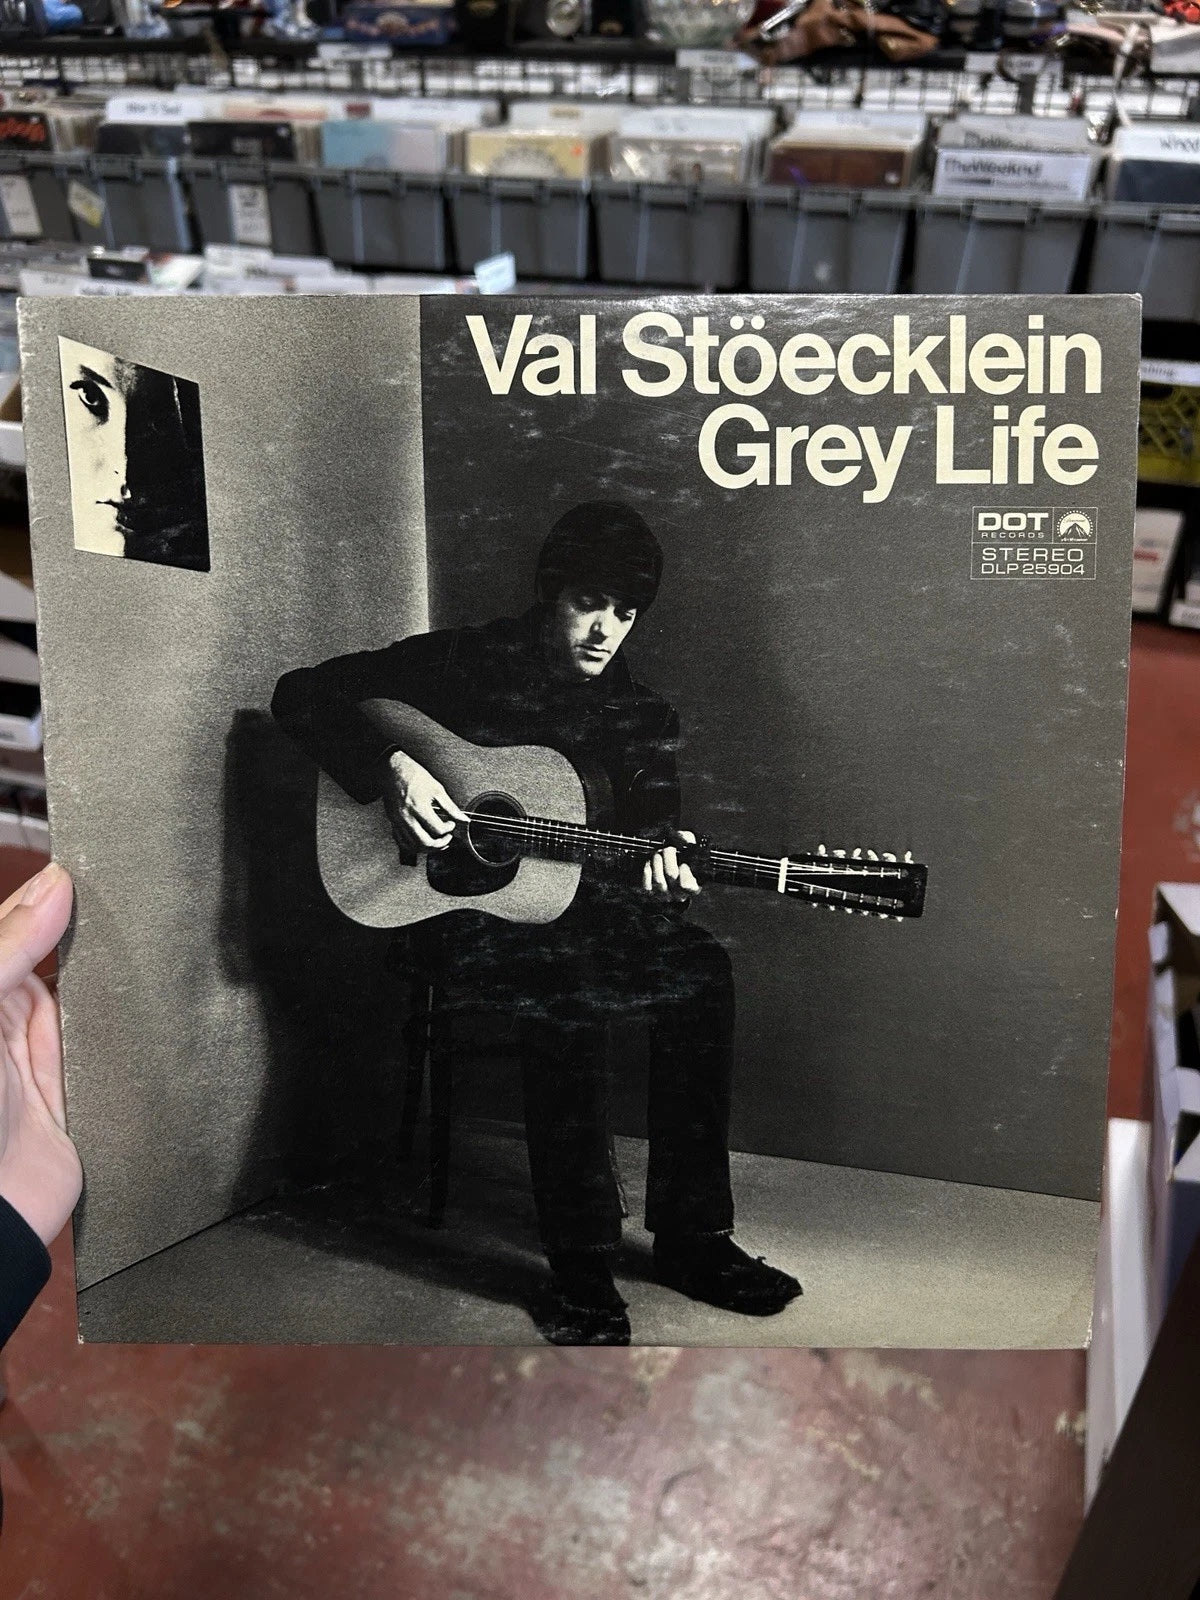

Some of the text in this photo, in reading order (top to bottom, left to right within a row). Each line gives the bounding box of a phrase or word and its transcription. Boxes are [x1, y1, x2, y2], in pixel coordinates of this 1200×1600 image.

[465, 311, 1102, 398] Val Stöecklein
[697, 402, 1100, 504] Grey Life
[978, 513, 1049, 531] DOT
[982, 547, 1084, 562] STEREO
[981, 563, 1085, 575] DLP 25904
